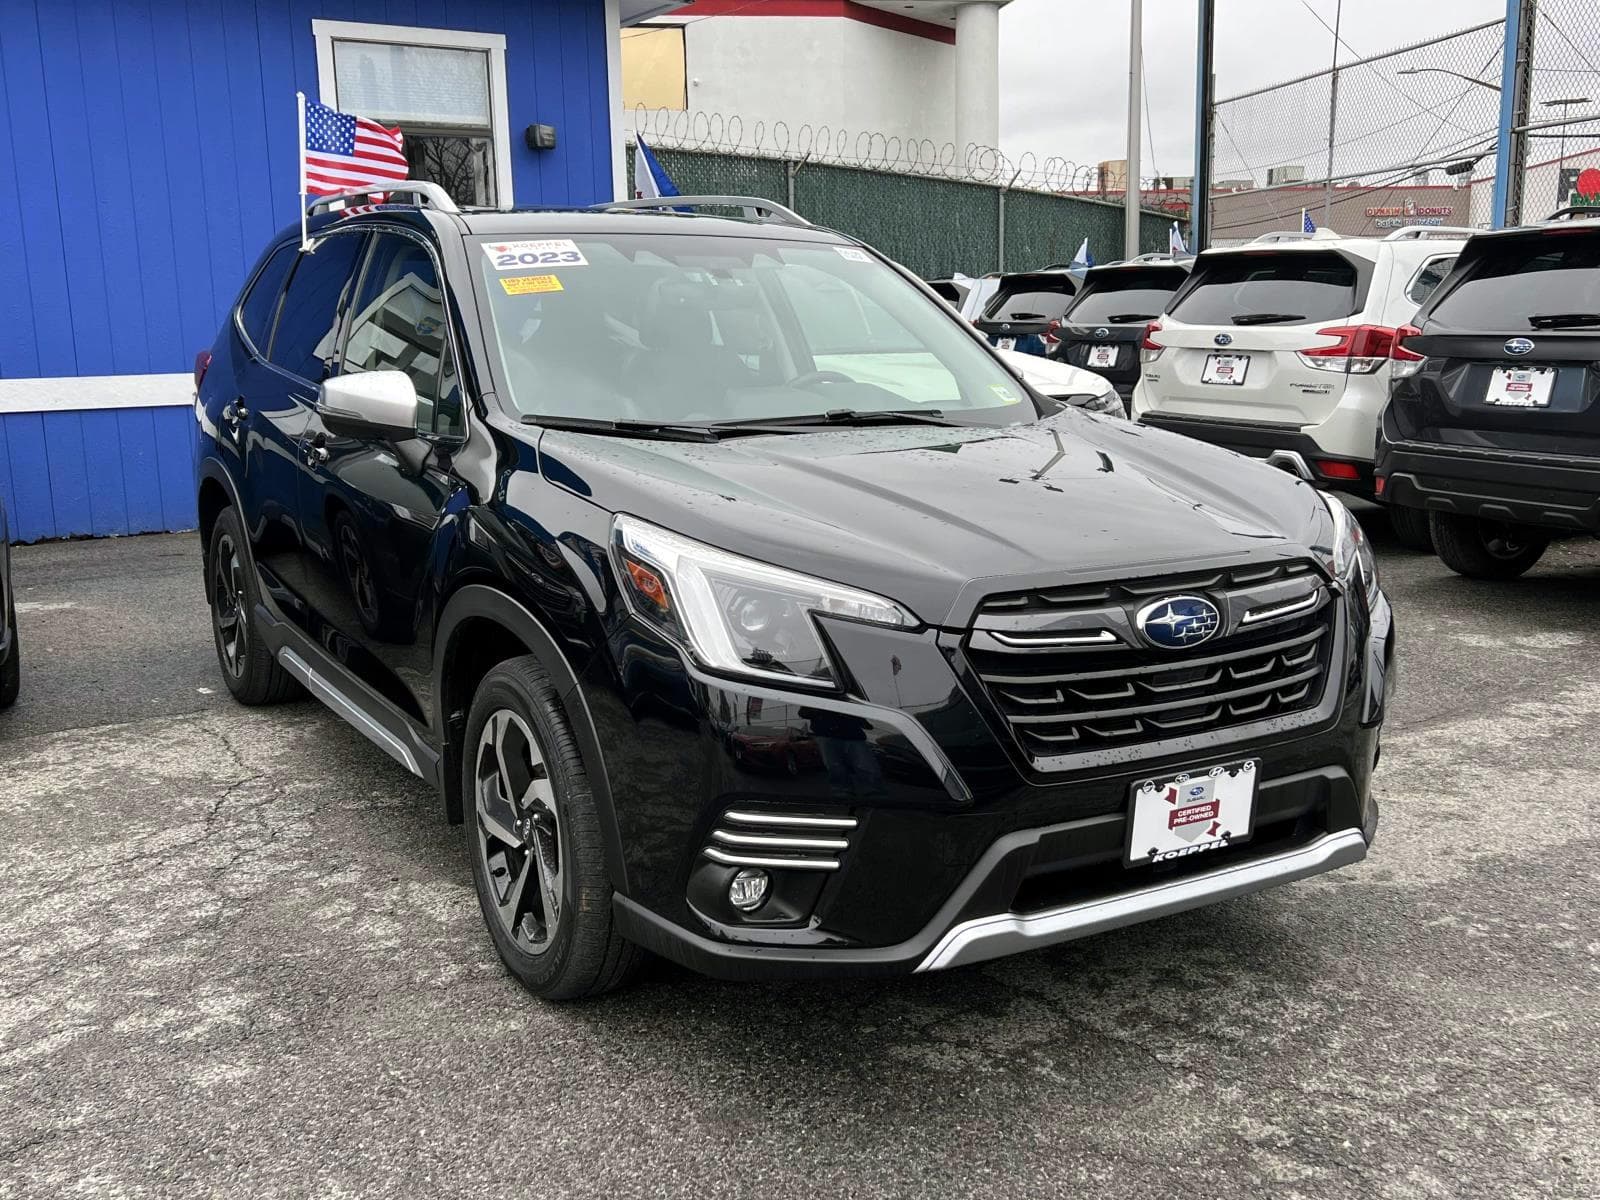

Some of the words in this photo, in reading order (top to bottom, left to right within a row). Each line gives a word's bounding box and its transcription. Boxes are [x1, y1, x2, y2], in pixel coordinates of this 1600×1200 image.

[1417, 206, 1453, 217] DONUTS
[496, 252, 581, 267] 2023
[1173, 811, 1214, 825] PRE-OWNED
[1177, 805, 1212, 817] CERTIFIED
[1152, 839, 1229, 863] KOEPPEL
